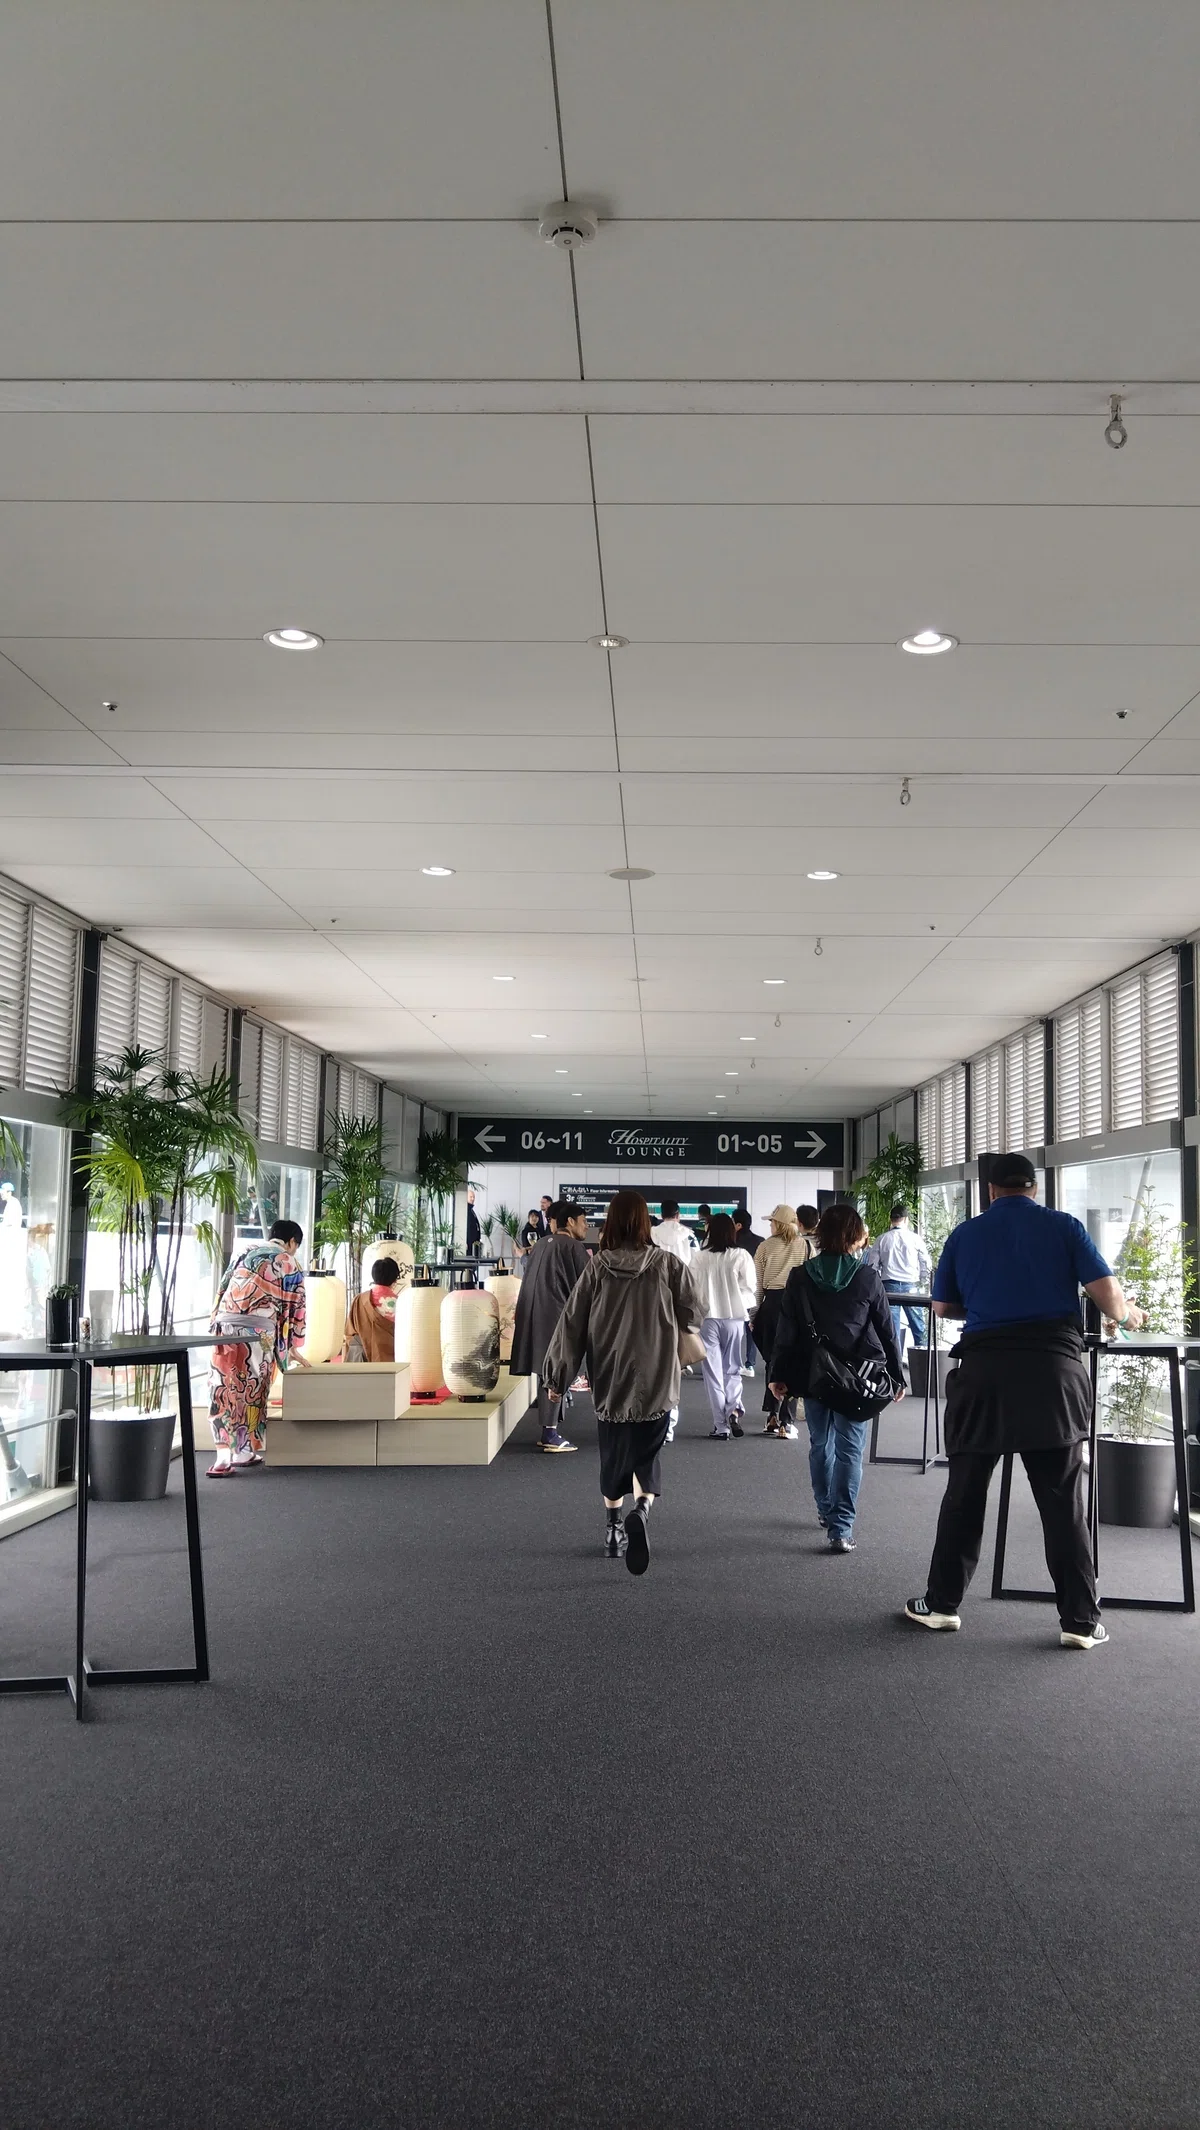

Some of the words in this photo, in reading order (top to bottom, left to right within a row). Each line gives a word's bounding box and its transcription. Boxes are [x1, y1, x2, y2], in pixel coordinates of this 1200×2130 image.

[521, 1131, 582, 1150] 06~11
[608, 1128, 691, 1146] HOSPITALITY
[718, 1133, 782, 1153] 01~05
[616, 1146, 686, 1156] LOUNGE
[565, 1194, 575, 1202] 3F
